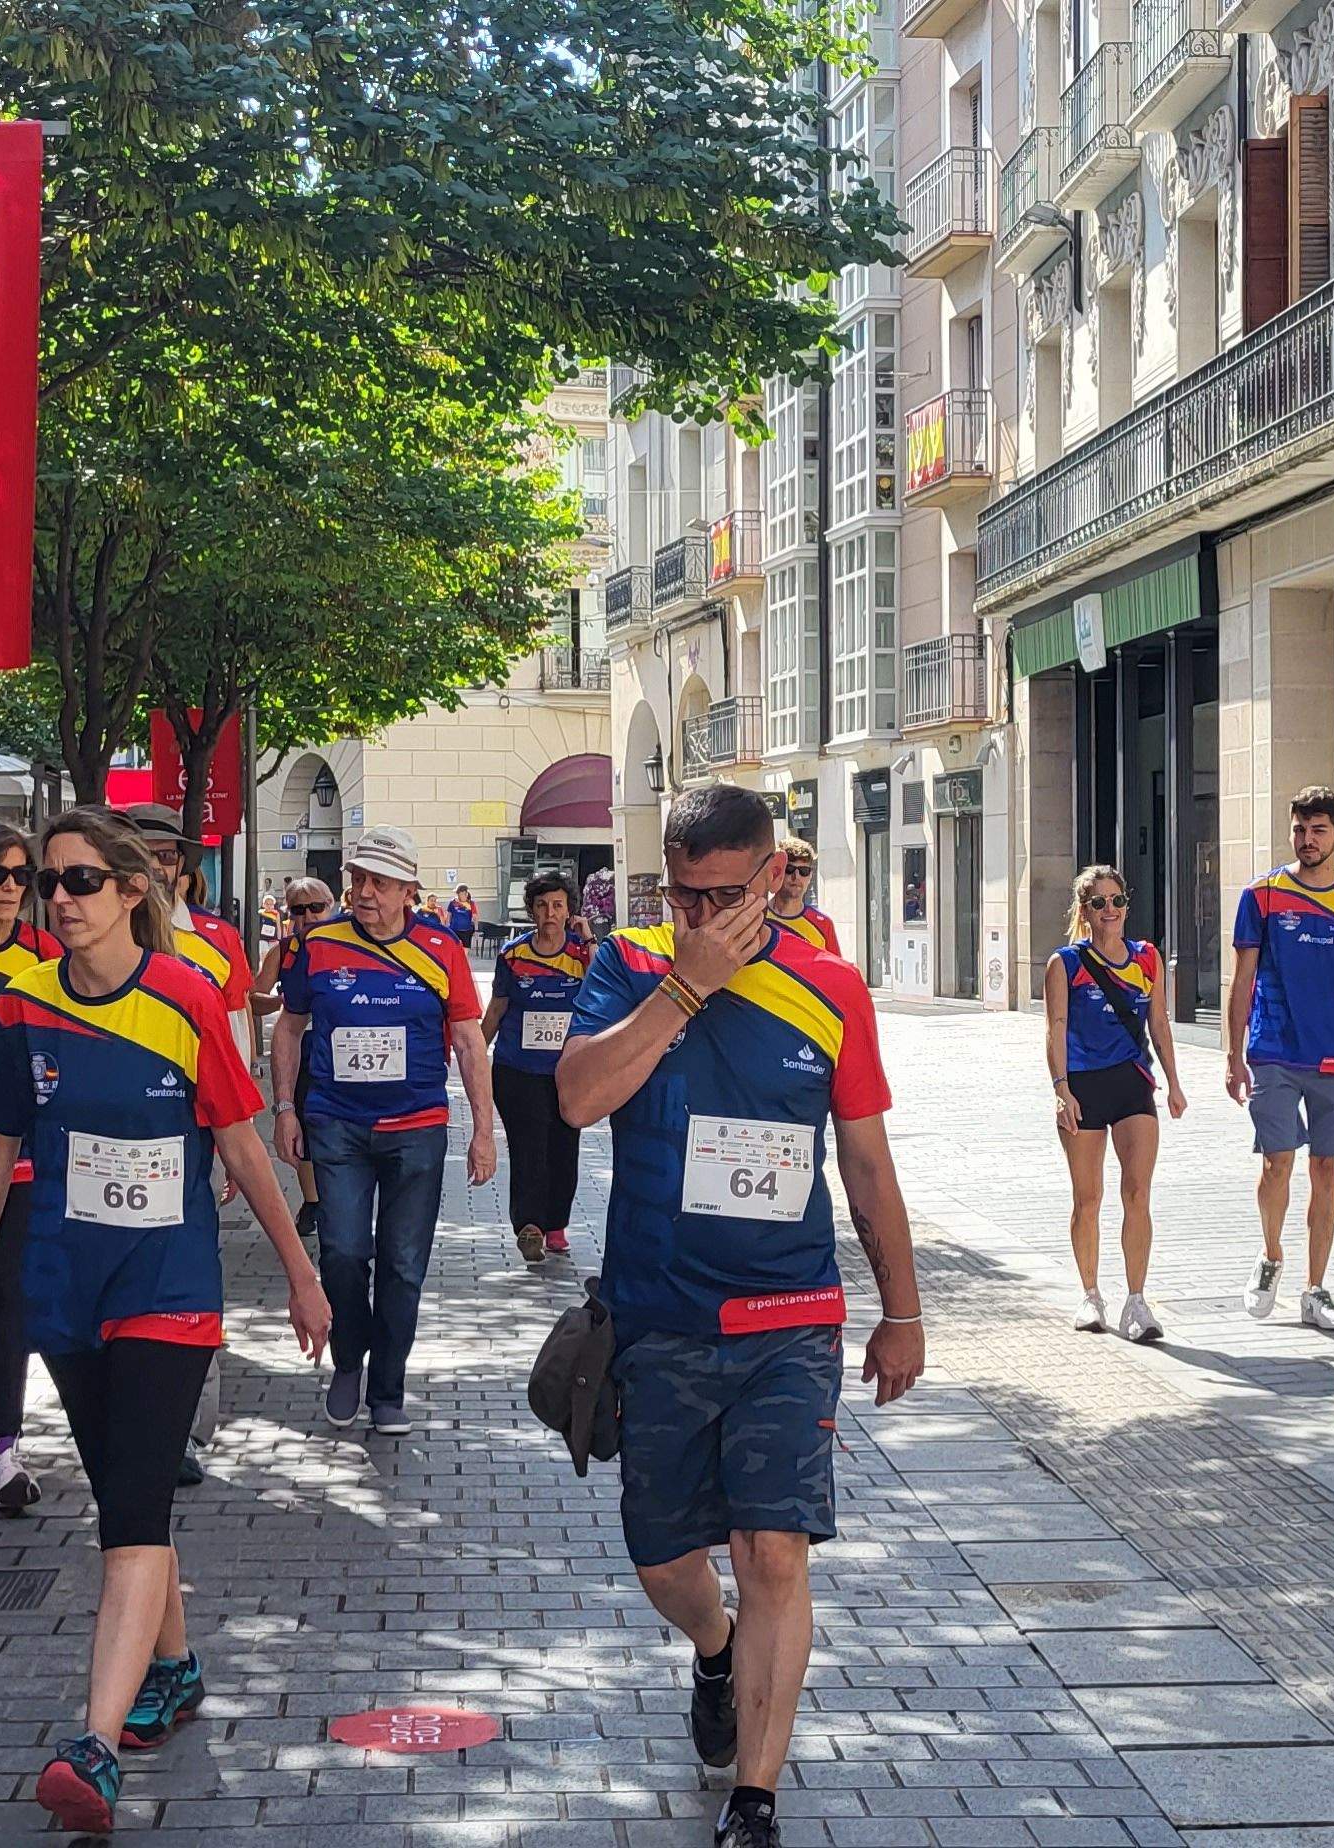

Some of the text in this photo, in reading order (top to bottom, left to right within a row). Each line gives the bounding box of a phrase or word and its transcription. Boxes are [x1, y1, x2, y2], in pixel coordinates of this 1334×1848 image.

[371, 995, 400, 1006] mupol
[534, 1030, 563, 1042] 208
[347, 1053, 390, 1071] 437
[782, 1057, 826, 1076] Santander
[729, 1168, 779, 1201] 64
[103, 1181, 149, 1211] 66
